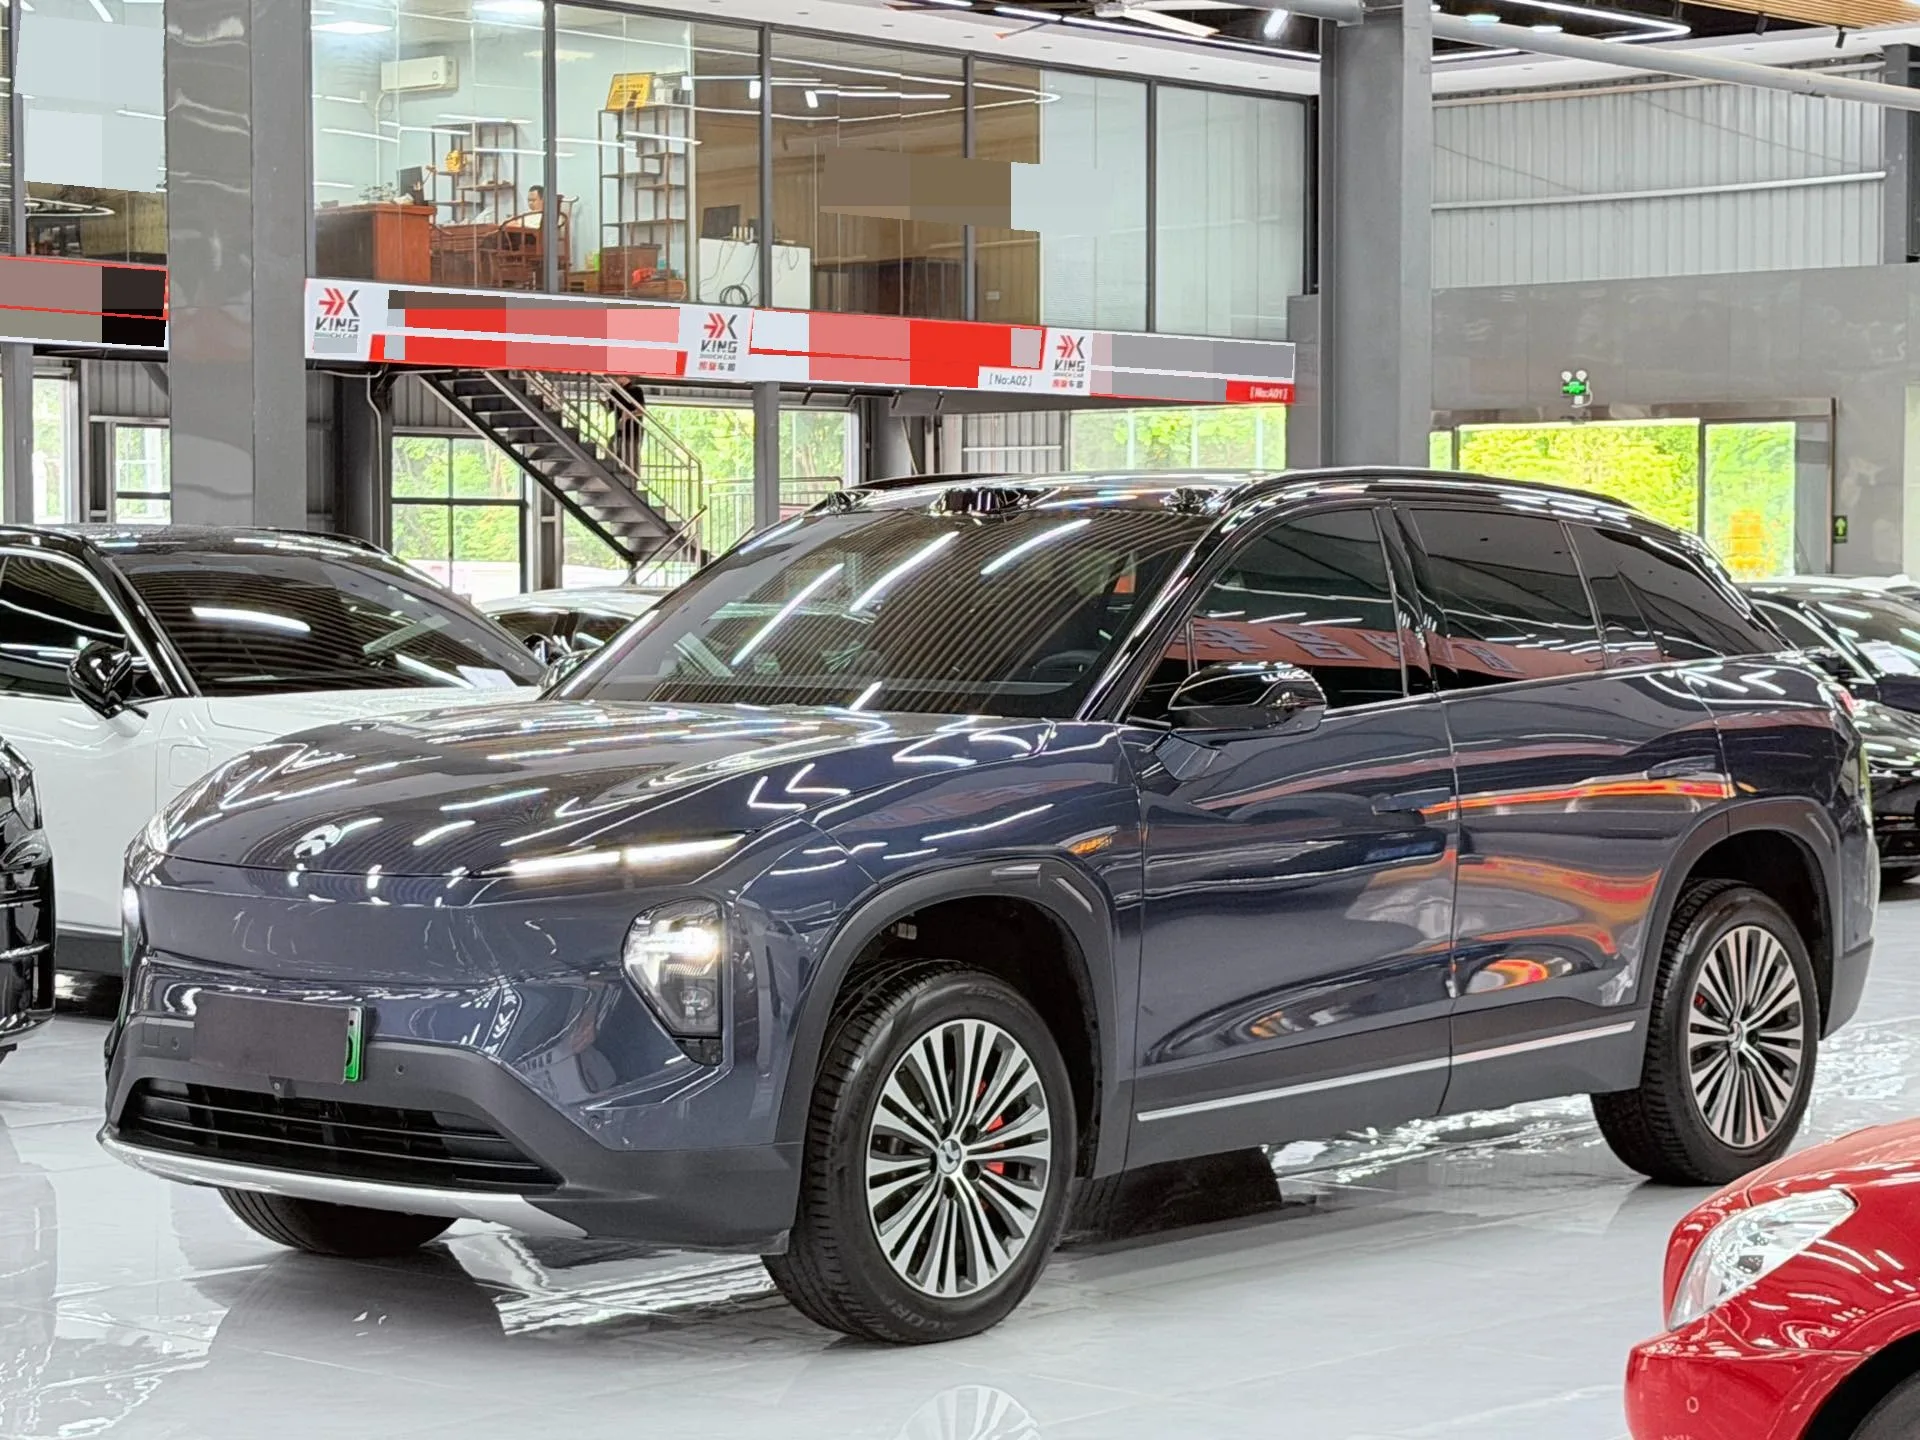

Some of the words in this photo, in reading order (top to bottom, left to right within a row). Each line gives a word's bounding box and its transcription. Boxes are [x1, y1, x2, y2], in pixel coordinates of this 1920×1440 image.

[315, 316, 360, 332] KING
[700, 339, 738, 353] KING
[1054, 359, 1085, 372] KING
